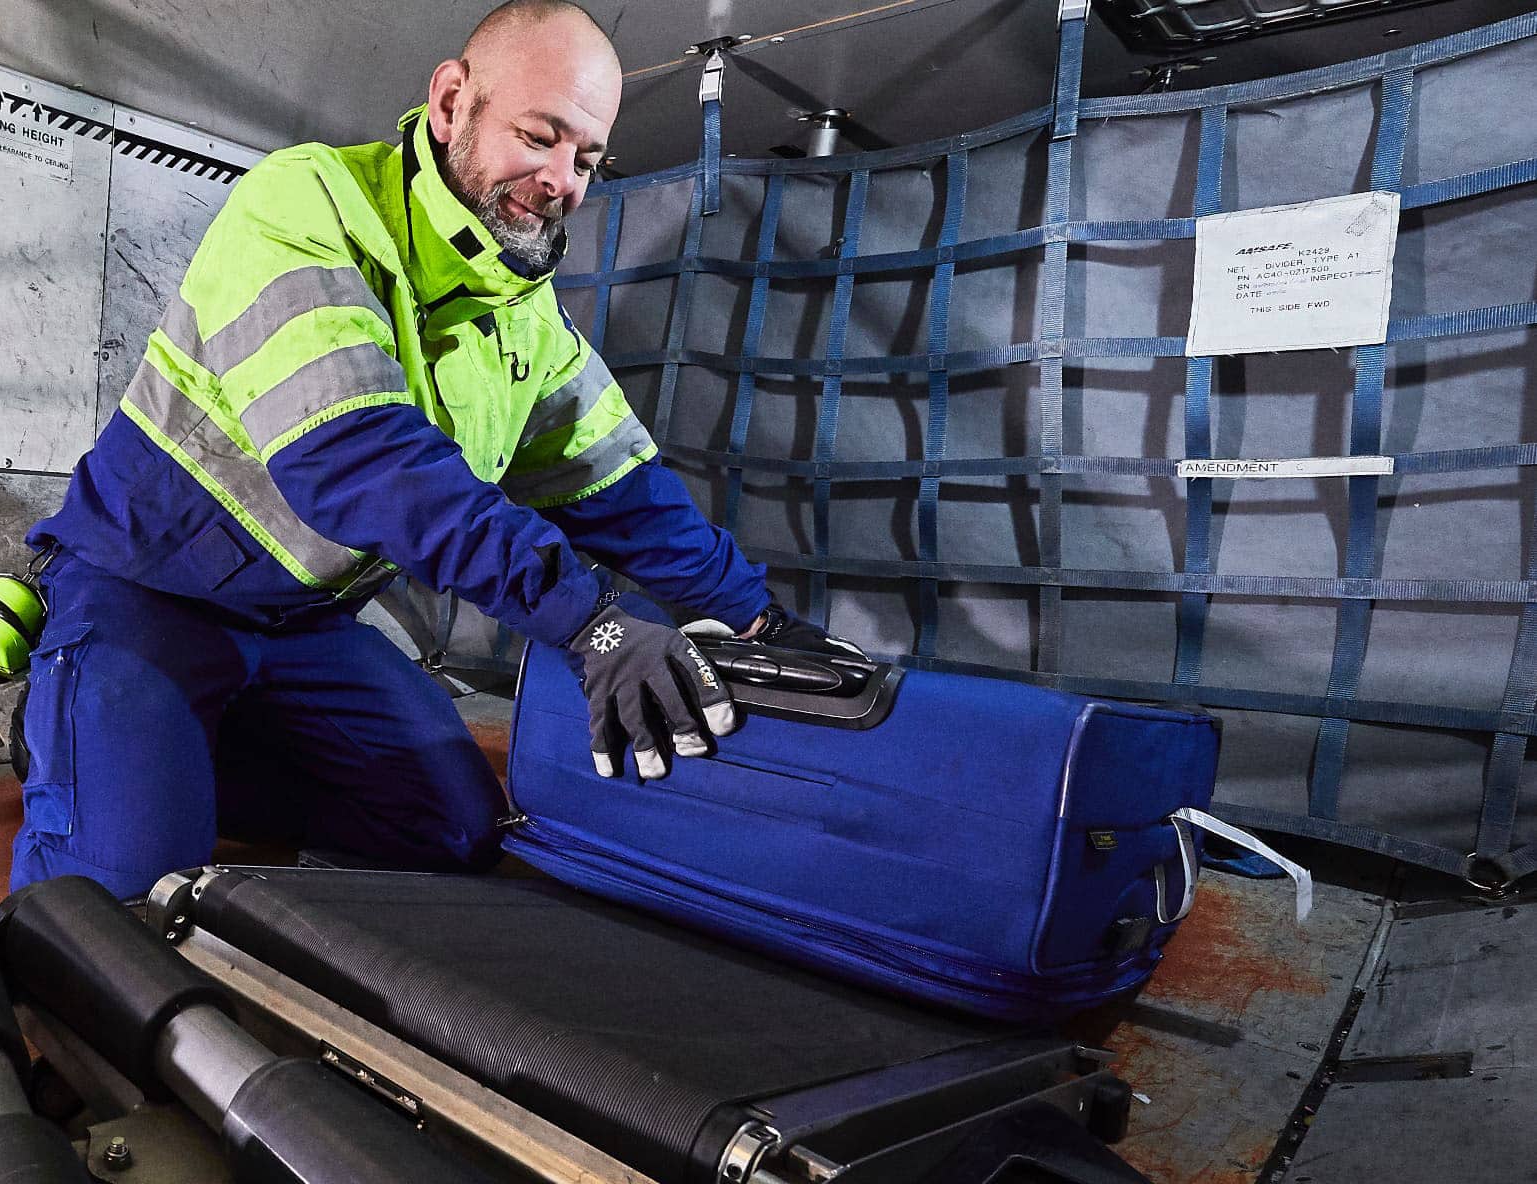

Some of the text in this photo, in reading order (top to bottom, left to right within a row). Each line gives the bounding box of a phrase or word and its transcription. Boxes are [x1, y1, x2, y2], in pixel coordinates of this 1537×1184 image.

[22, 126, 64, 148] HEIGHT
[34, 154, 43, 162] TO
[44, 157, 69, 170] CEILING
[1298, 247, 1330, 257] K2429
[1312, 254, 1339, 263] TYPE
[1347, 252, 1360, 260] A1
[1236, 283, 1250, 291] SN
[1310, 271, 1353, 282] INSPECT
[1235, 291, 1263, 300] DATE
[1250, 300, 1330, 314] THIS SIDE FWD
[1185, 462, 1279, 473] AMENDMENT
[687, 647, 719, 690] water
